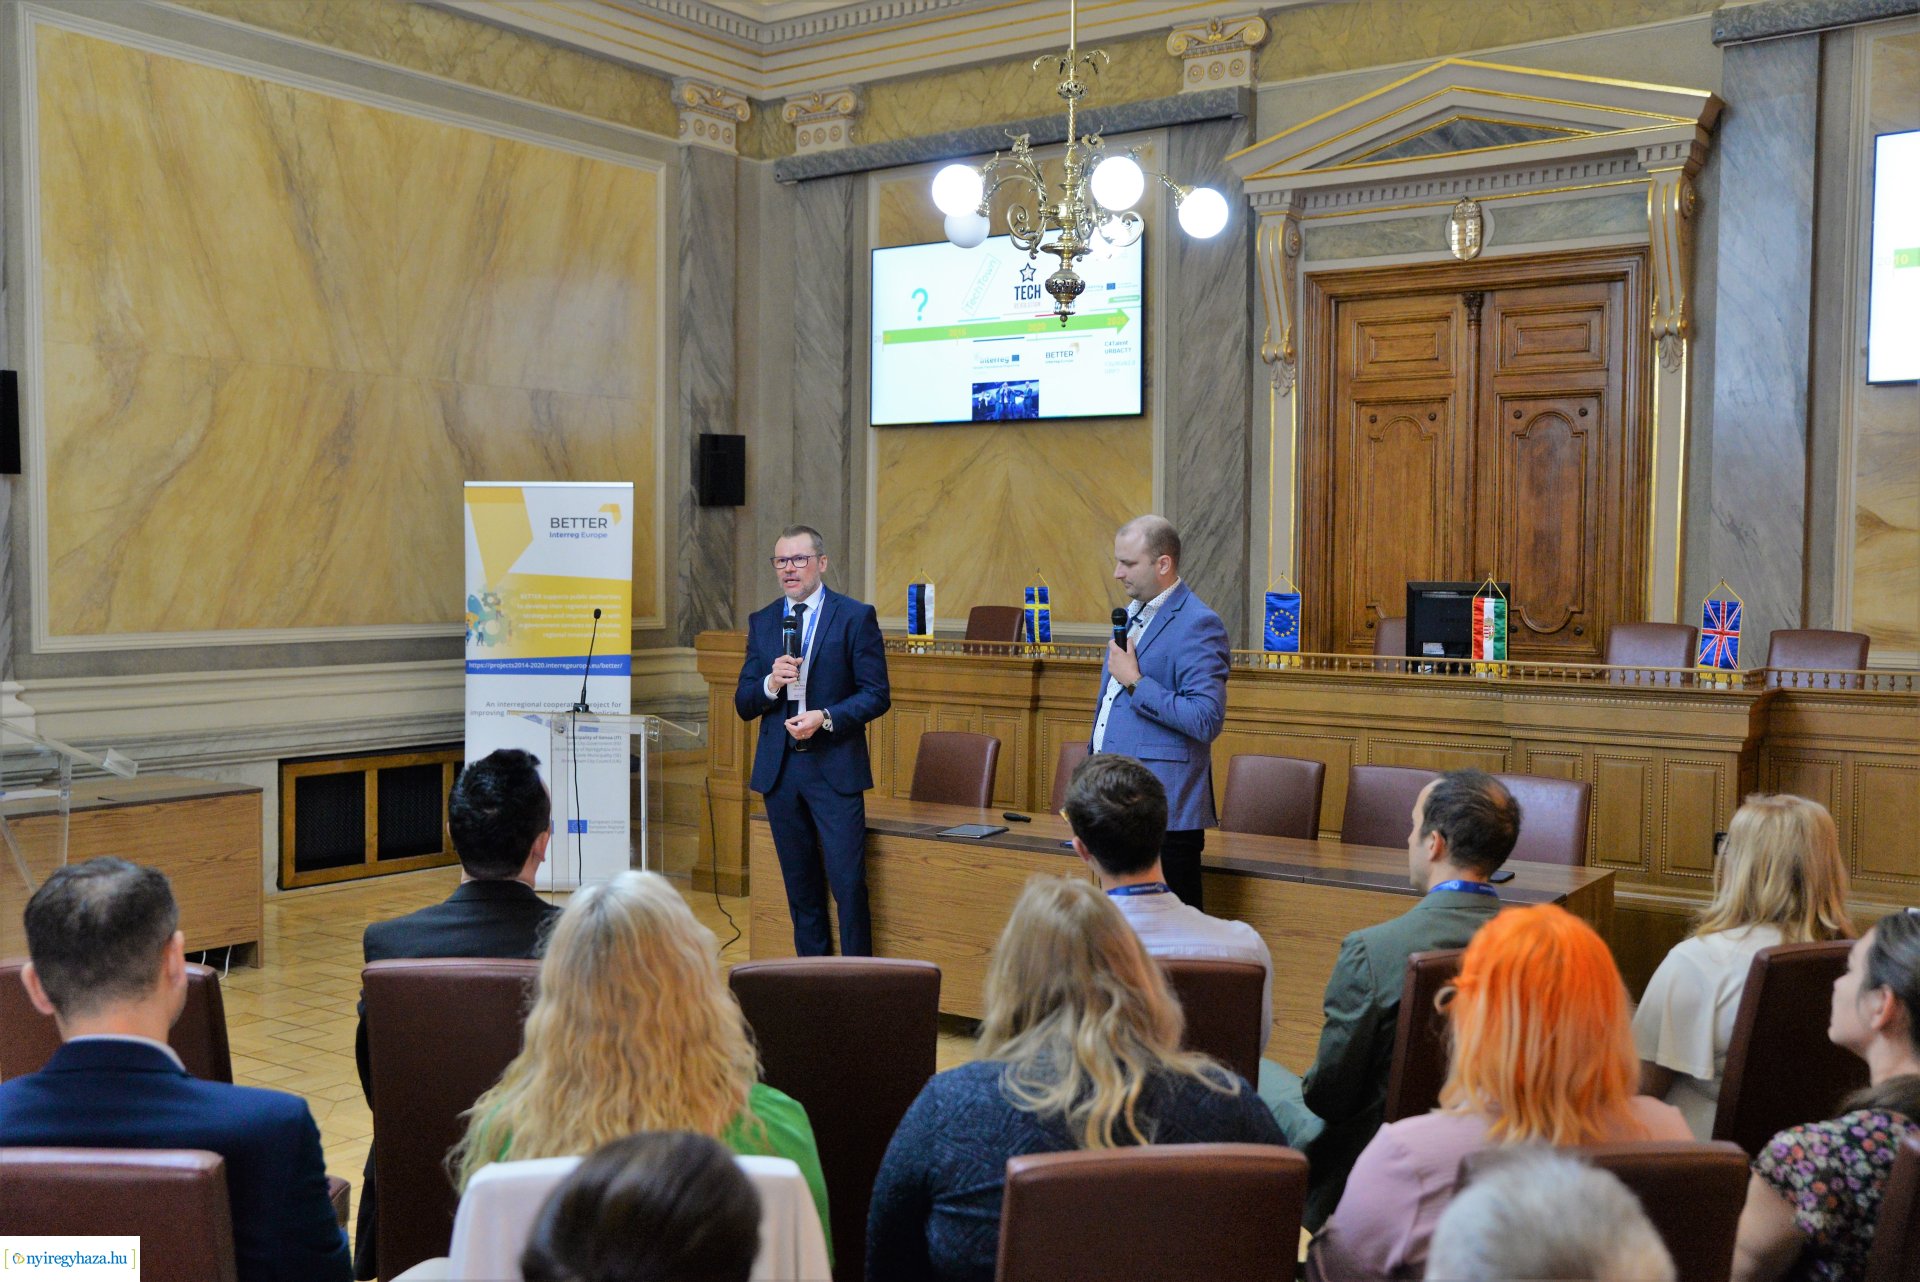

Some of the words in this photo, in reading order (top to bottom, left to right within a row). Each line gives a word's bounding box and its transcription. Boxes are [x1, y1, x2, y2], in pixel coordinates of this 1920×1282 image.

[1014, 284, 1041, 300] TECH
[1045, 350, 1074, 359] BETTER
[550, 517, 608, 529] BETTER
[549, 531, 580, 539] Interreg
[497, 701, 542, 711] interregional
